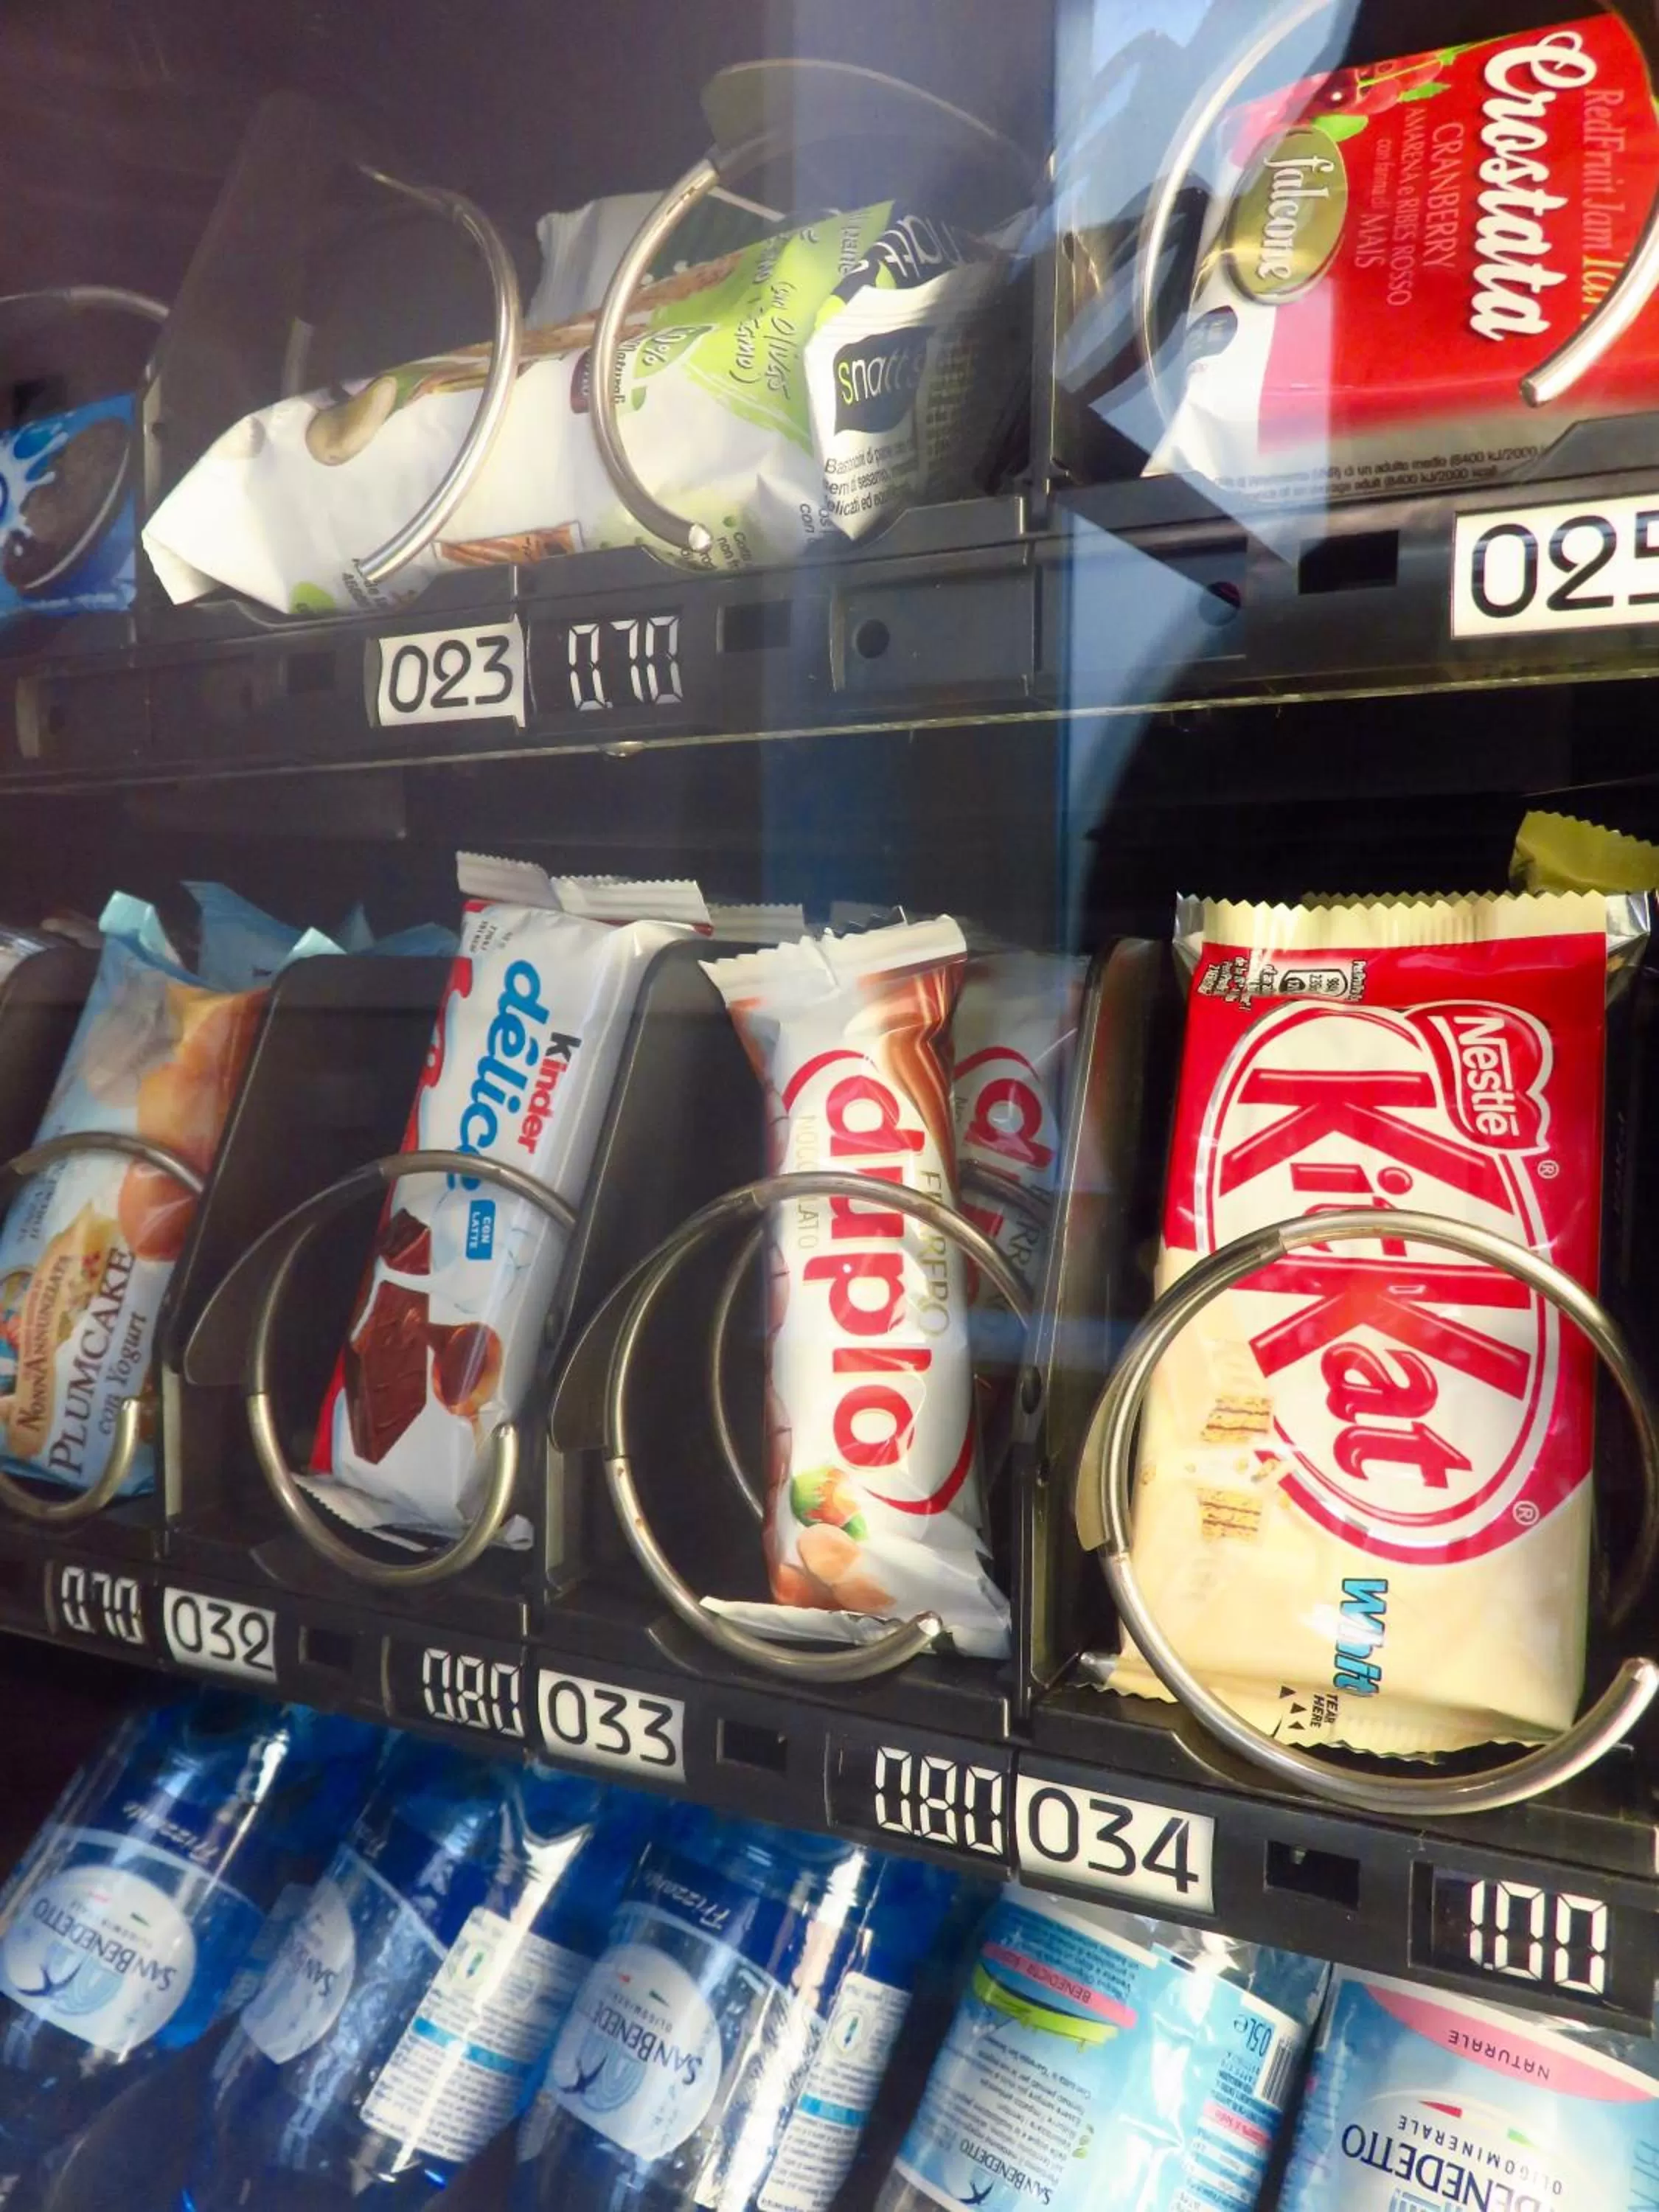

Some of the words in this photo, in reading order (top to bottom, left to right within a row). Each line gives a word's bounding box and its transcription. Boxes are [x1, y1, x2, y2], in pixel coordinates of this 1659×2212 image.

[1399, 107, 1427, 184] AMARENA
[1256, 154, 1335, 282] falcone
[1393, 197, 1420, 241] RIBES
[1422, 122, 1465, 268] CRANBERRY
[1469, 31, 1597, 343] Crostata
[1582, 199, 1625, 251] Jam
[1354, 212, 1388, 268] MAIS
[1386, 244, 1416, 307] ROSSO
[1581, 253, 1626, 322] Tar
[388, 635, 515, 714] 023
[1450, 1015, 1520, 1149] Nestlé
[792, 1113, 819, 1251] NOCCLATO
[468, 1211, 481, 1250] LATTE
[480, 1217, 492, 1245] CON
[919, 1169, 950, 1342] FRERO
[803, 1074, 933, 1470] duplo
[47, 1246, 136, 1476] PLUMCAKE
[105, 1311, 147, 1390] Yogurt
[171, 1595, 274, 1672] 032
[1333, 1577, 1389, 1698] Whit
[547, 1679, 678, 1767] 033
[1309, 1694, 1324, 1729] HERE
[1027, 1786, 1200, 1894] 034
[1447, 2028, 1551, 2081] NATURALE
